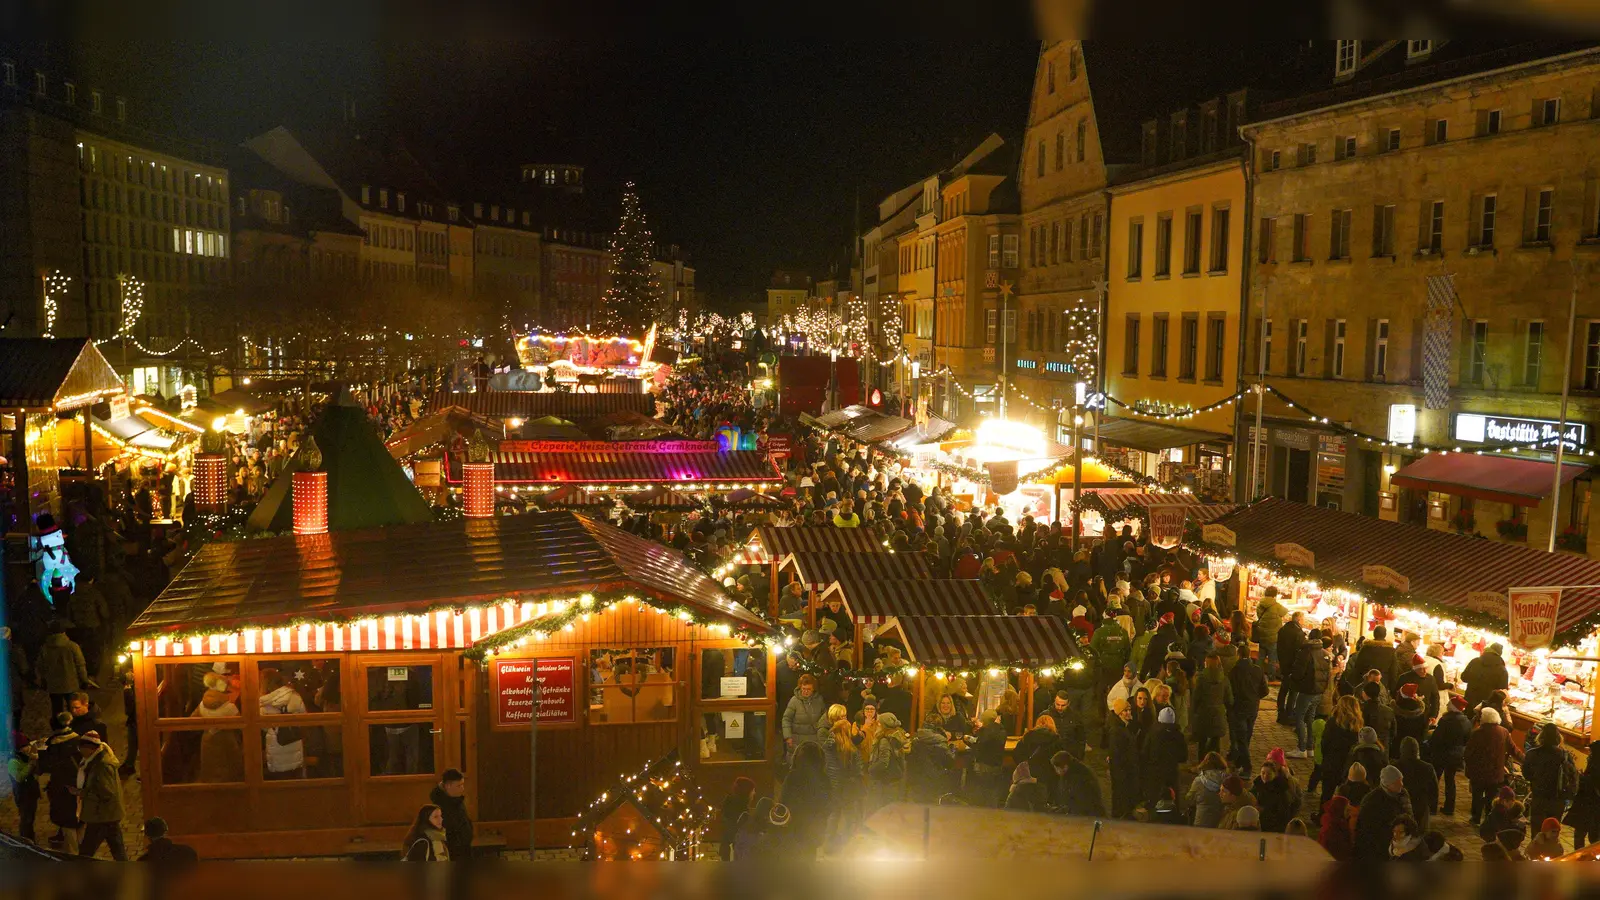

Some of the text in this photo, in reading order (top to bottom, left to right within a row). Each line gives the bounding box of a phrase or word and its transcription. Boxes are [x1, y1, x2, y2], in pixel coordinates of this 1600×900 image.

[1487, 419, 1540, 442] Gaststätte
[1514, 601, 1555, 619] Mandeln
[501, 665, 531, 674] Glühwein
